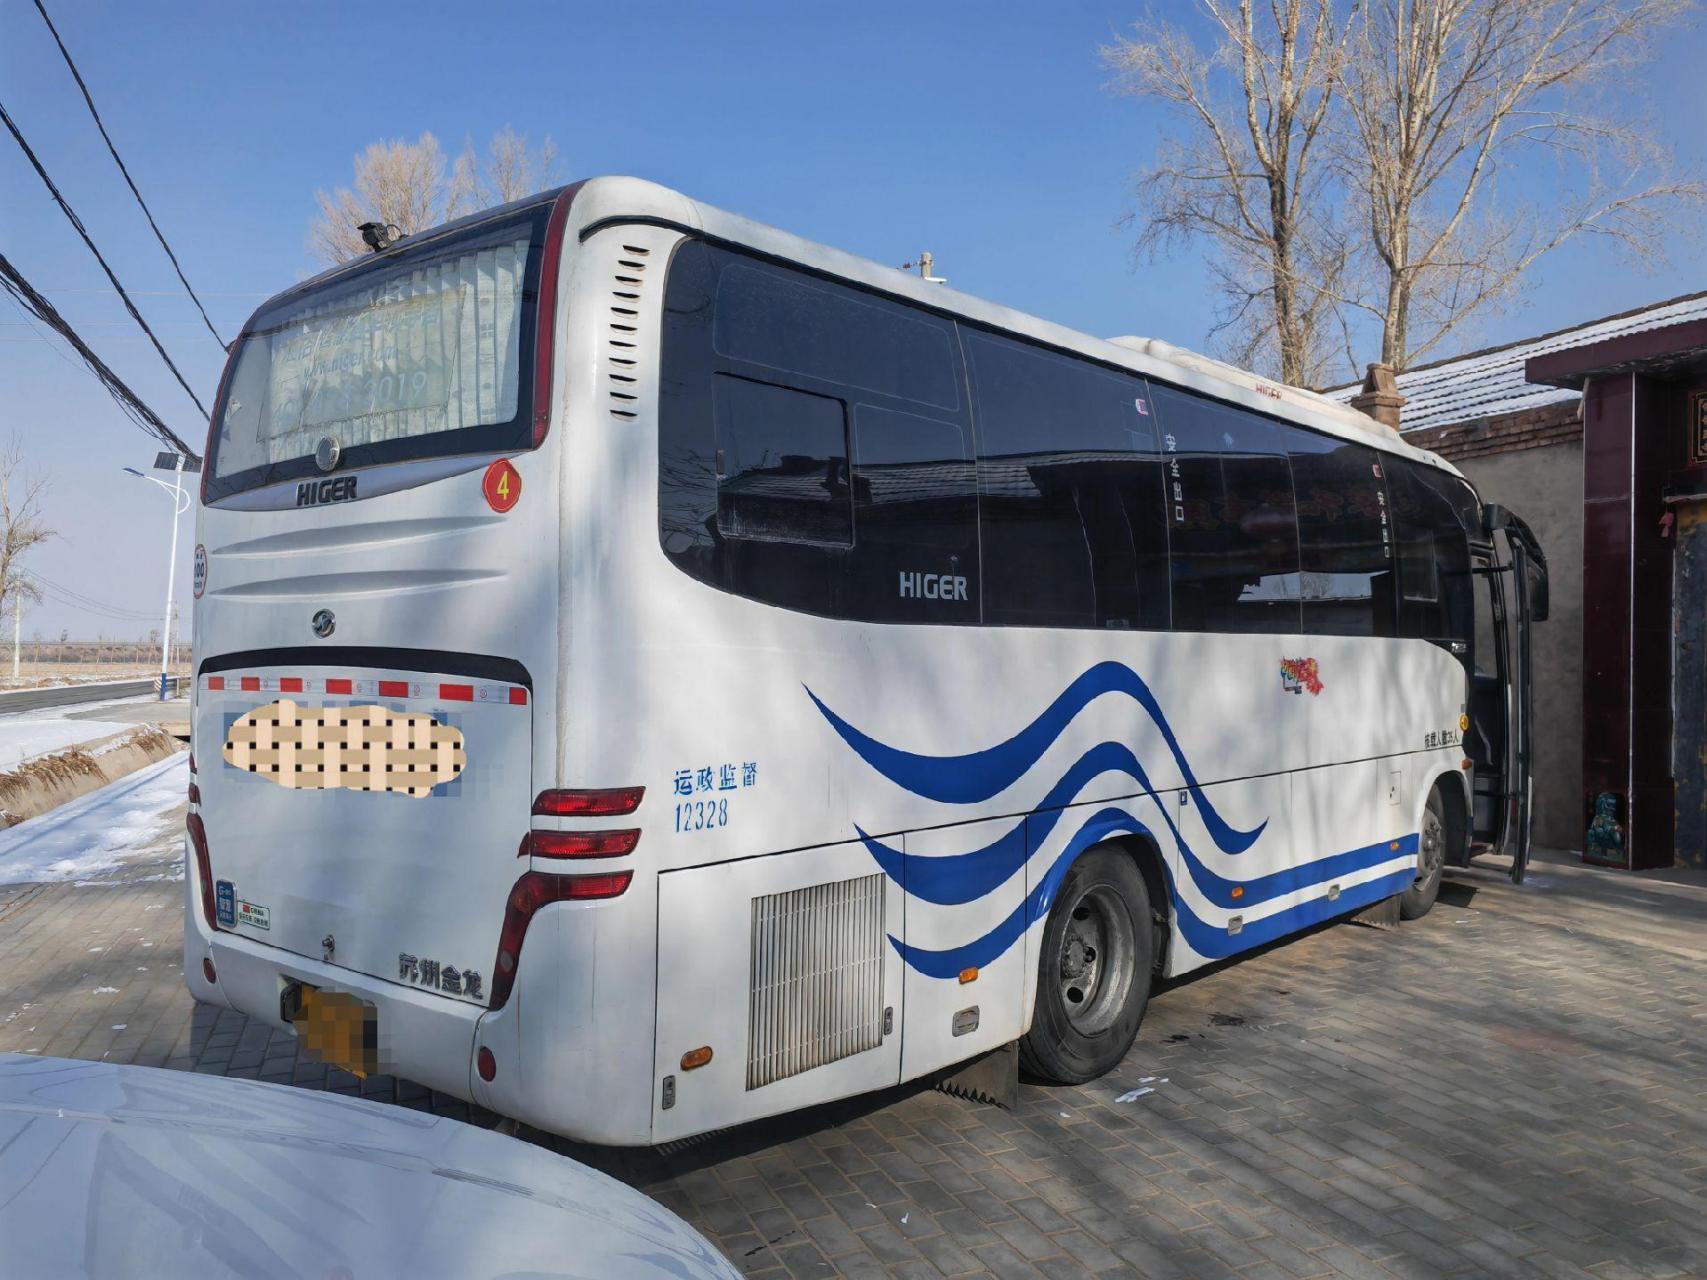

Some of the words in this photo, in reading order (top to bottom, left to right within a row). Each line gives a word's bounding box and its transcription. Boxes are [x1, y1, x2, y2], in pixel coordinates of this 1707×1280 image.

[297, 475, 358, 506] HIGER
[496, 471, 510, 500] 4
[1164, 433, 1185, 522] 安全出口
[899, 571, 969, 601] HIGER
[673, 761, 758, 796] 运政监督
[675, 798, 728, 833] 12328
